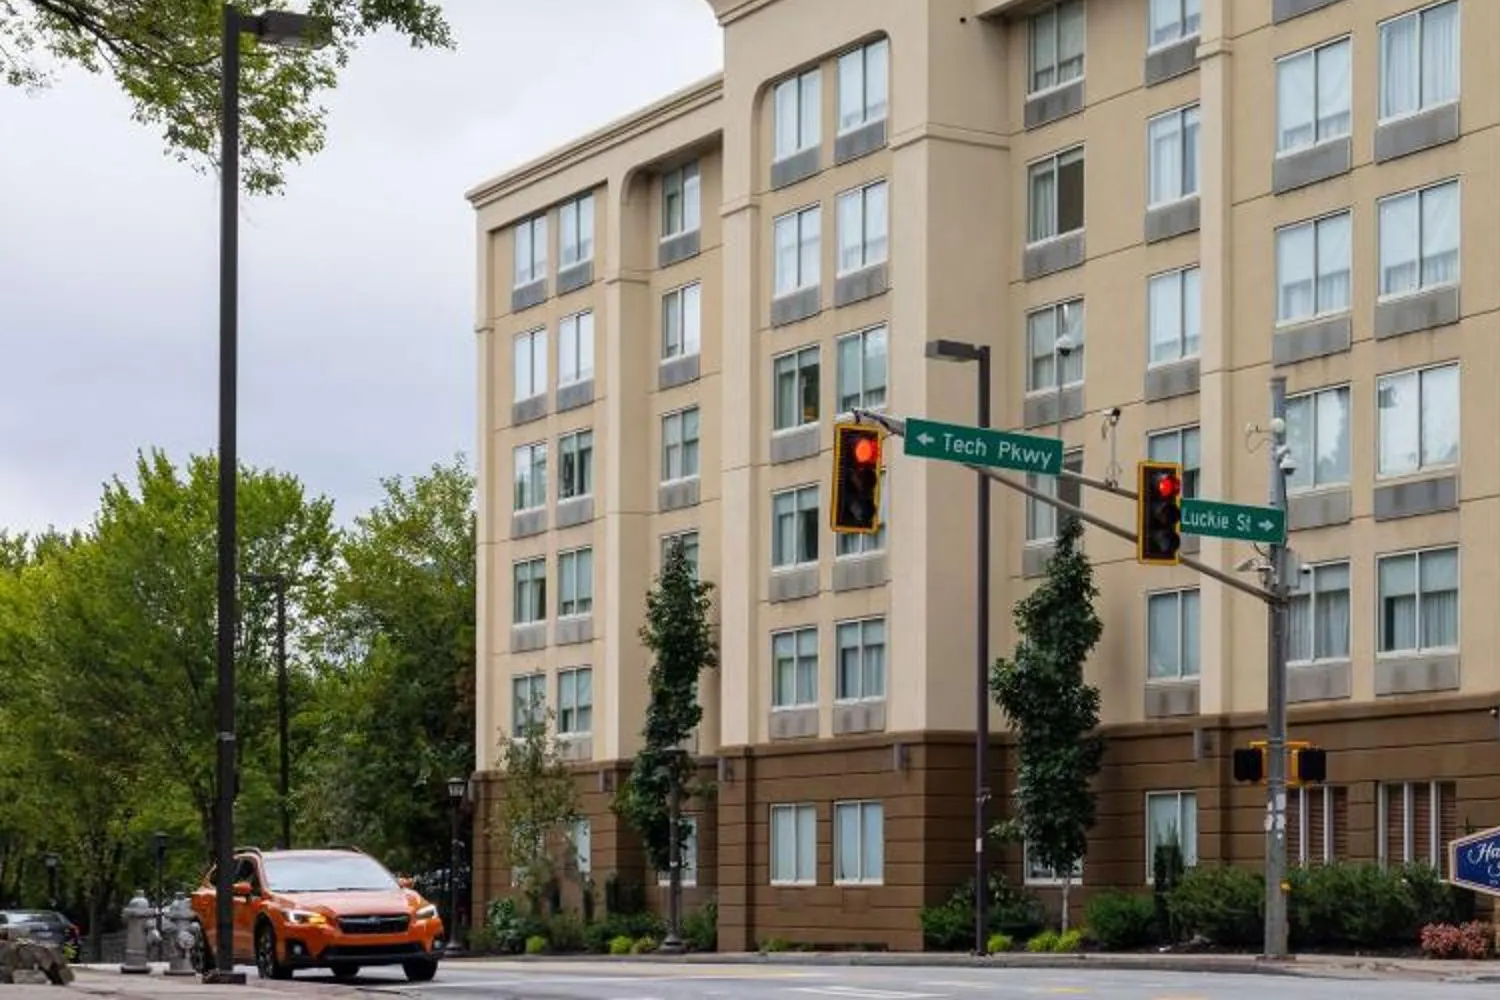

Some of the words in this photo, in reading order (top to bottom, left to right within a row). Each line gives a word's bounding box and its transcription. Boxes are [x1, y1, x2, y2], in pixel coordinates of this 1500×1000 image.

[943, 433, 987, 457] Tech
[998, 440, 1052, 470] Pkwy
[1181, 508, 1229, 529] Luckie
[1236, 513, 1252, 532] St
